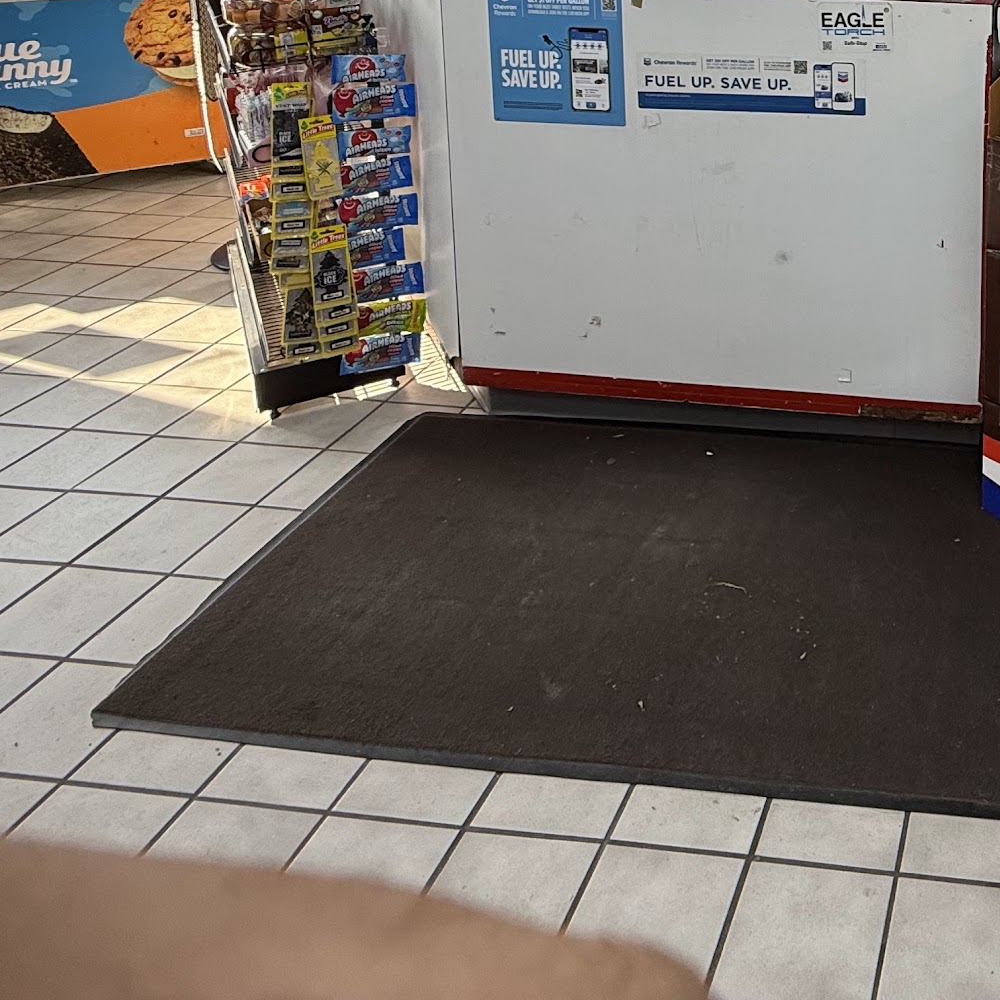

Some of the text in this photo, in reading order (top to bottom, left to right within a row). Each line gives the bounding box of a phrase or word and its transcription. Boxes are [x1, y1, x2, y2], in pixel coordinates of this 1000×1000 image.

[821, 7, 885, 28] EAGLE
[501, 49, 561, 69] FUEL UP.
[5, 80, 47, 89] CREAM
[342, 69, 386, 83] AIRHEADS
[501, 70, 562, 89] SAVE UP.
[645, 75, 792, 91] FUEL UP. SAVE UP.
[352, 84, 397, 104] AIRHEADS
[301, 124, 333, 139] Little Trees
[345, 138, 388, 157] AIRHEADS
[349, 158, 392, 180] AIRHEADS
[311, 232, 345, 250] Little Trees
[323, 276, 338, 284] ICE
[363, 264, 407, 287] AIRHEADS
